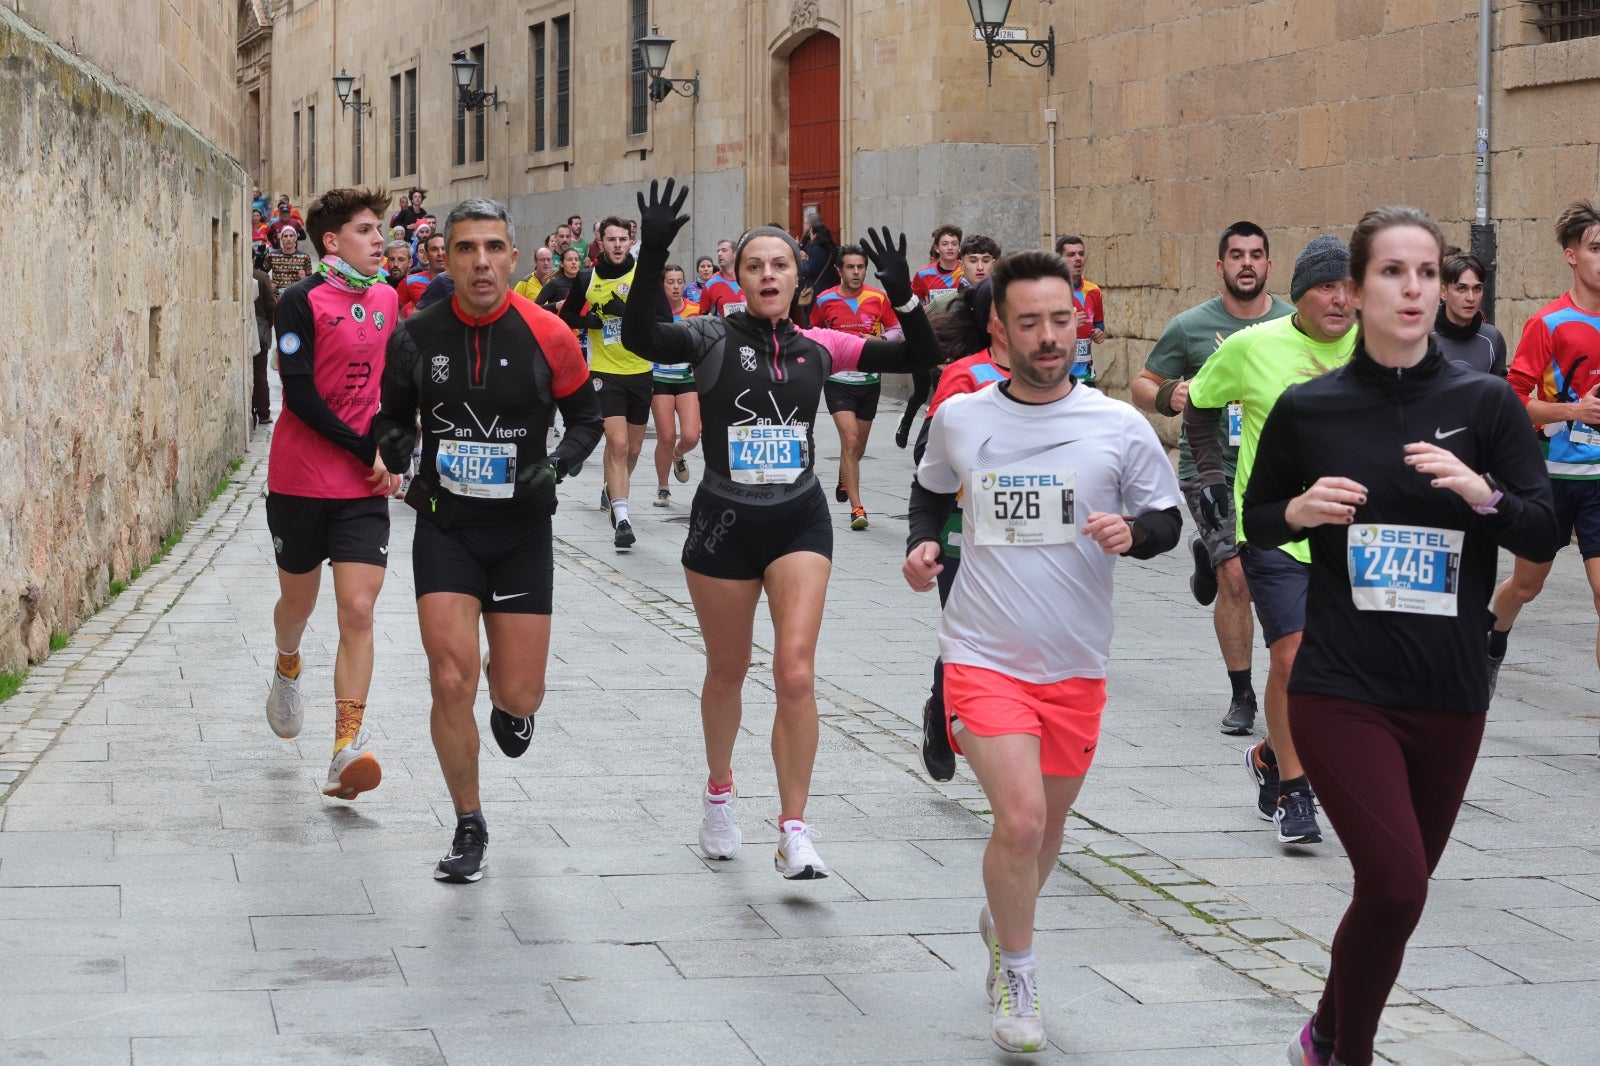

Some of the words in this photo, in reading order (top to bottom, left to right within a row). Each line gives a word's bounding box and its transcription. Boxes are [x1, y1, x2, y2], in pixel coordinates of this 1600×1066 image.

[732, 388, 772, 427] San
[431, 402, 472, 437] San
[464, 402, 527, 438] Vitero
[751, 428, 800, 439] SETEL
[458, 444, 509, 456] SETEL
[740, 440, 791, 464] 4203
[450, 456, 493, 479] 4194
[998, 475, 1064, 487] SETEL
[994, 490, 1040, 520] 526
[704, 508, 736, 554] PRO
[1381, 529, 1450, 549] SETEL
[1364, 546, 1435, 585] 2446
